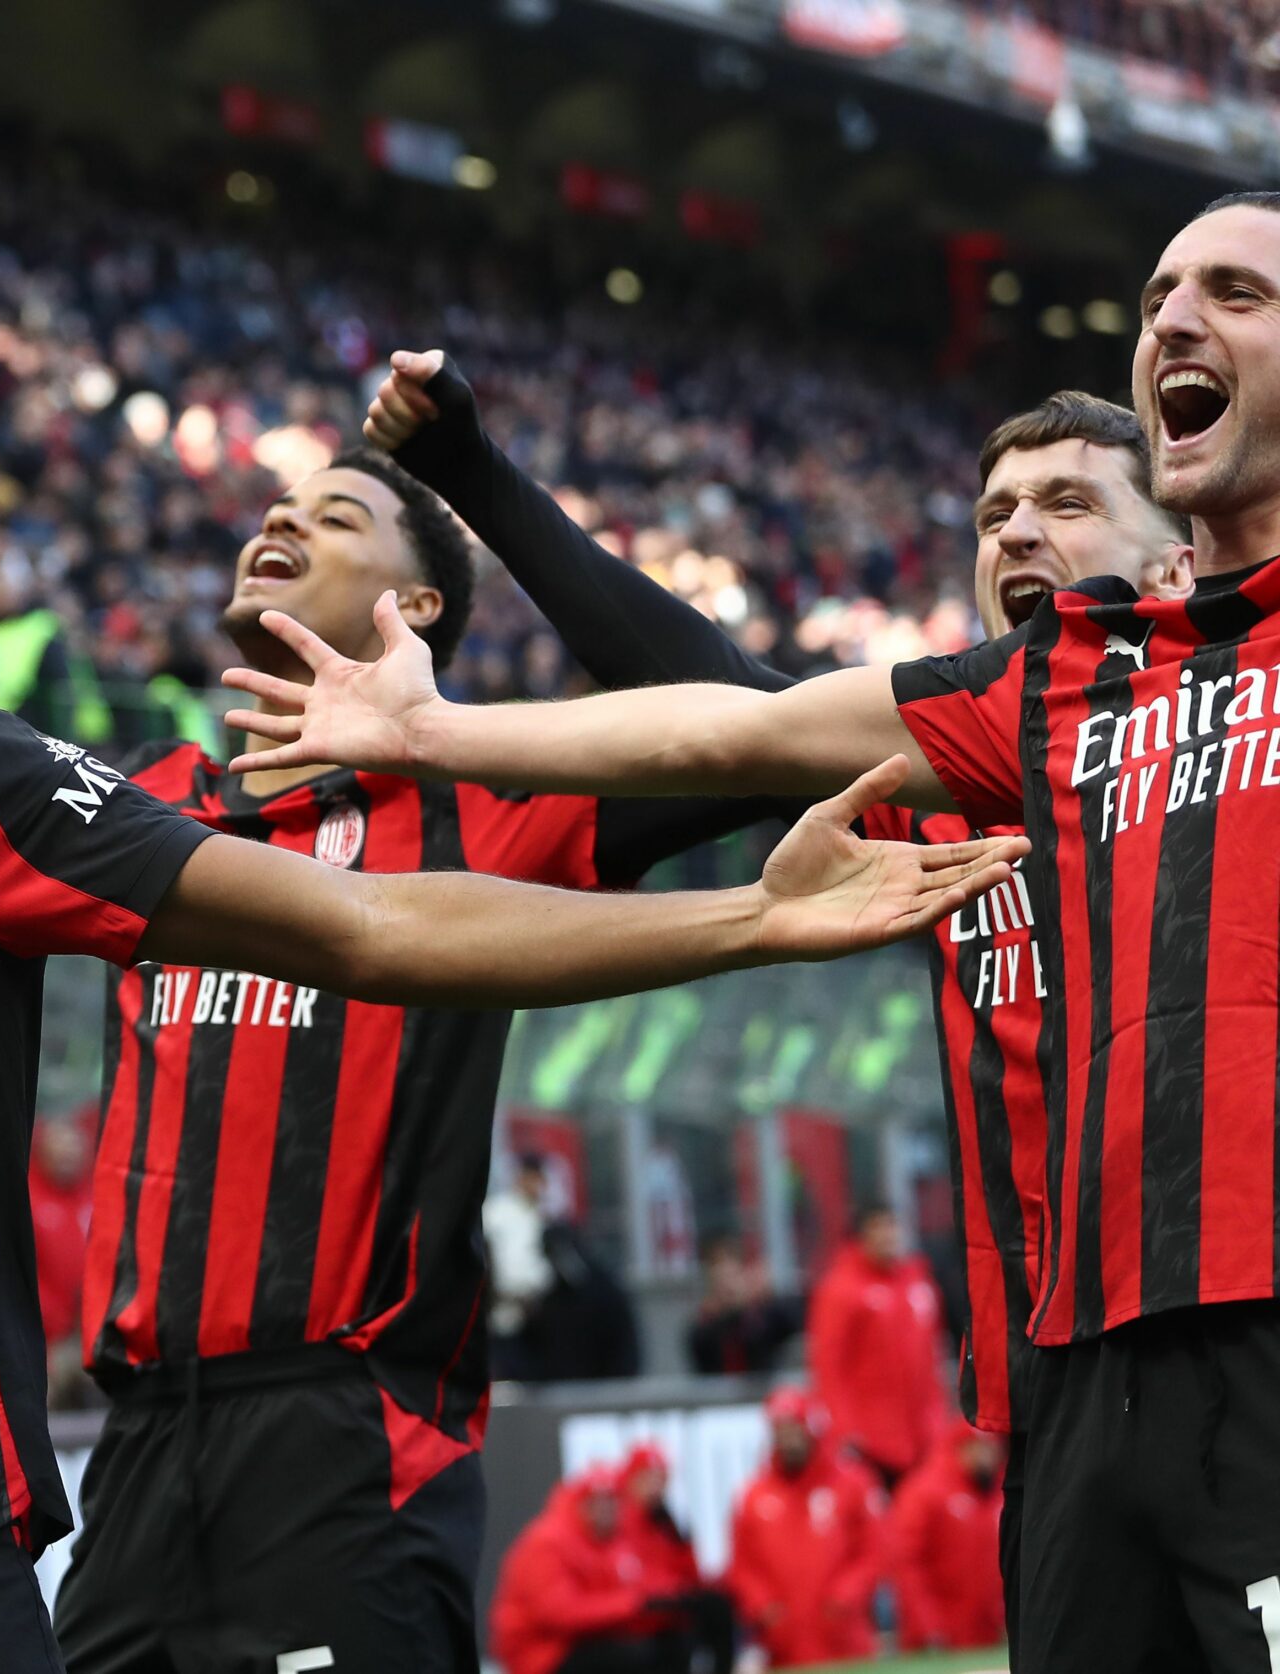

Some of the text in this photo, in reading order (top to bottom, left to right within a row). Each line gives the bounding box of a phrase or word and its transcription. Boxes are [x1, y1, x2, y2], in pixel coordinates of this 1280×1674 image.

[1100, 761, 1159, 843] FLY
[150, 970, 320, 1028] FLY BETTER
[973, 943, 1020, 1009] FLY
